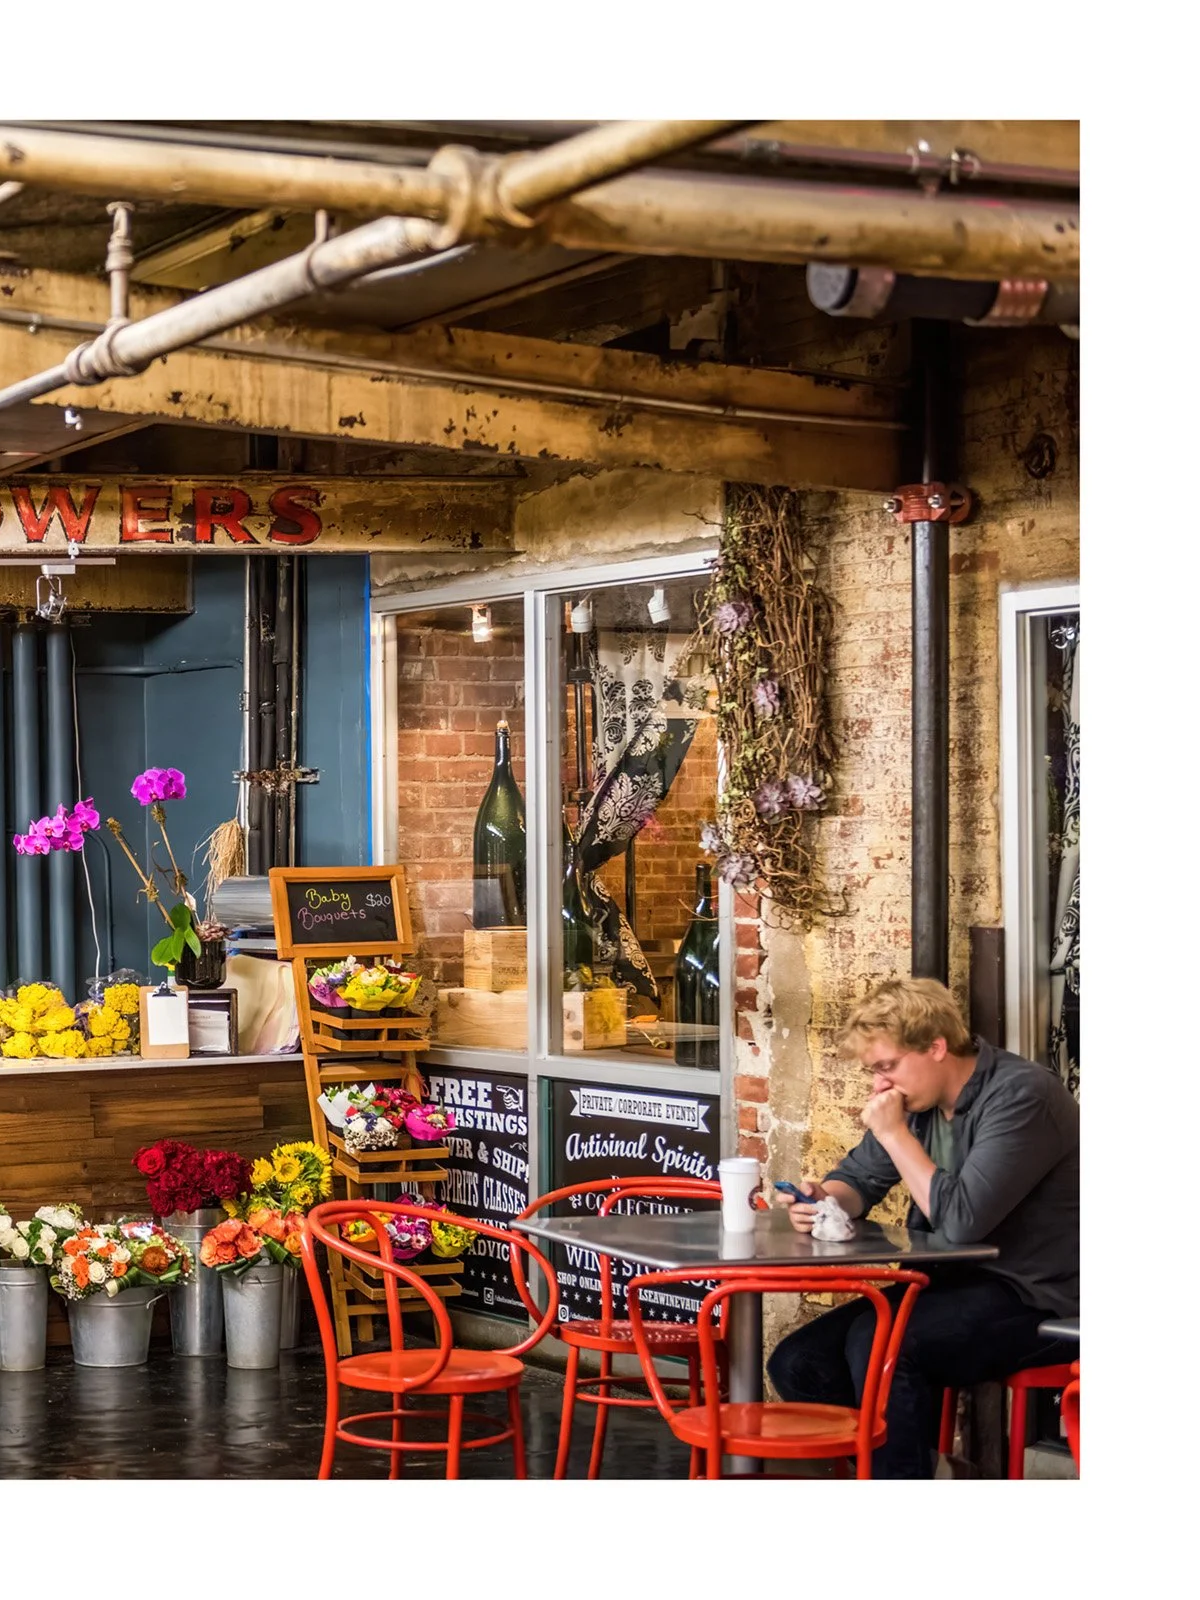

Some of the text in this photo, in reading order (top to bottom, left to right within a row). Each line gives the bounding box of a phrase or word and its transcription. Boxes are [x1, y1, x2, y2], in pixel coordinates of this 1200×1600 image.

[305, 888, 351, 911] Baby
[365, 893, 391, 908] $20
[298, 907, 366, 930] Bouquets
[429, 1075, 492, 1109] FREE
[666, 1105, 696, 1122] EVENTS
[477, 1141, 489, 1164] &
[492, 1147, 529, 1183] SHIP!
[565, 1132, 713, 1181] Artisinal Spirits
[441, 1168, 479, 1208] SPIRITS
[483, 1176, 527, 1215] CLASSES
[468, 1239, 510, 1262] ADVIC
[557, 1271, 577, 1287] SHOP
[579, 1275, 603, 1291] ONLI
